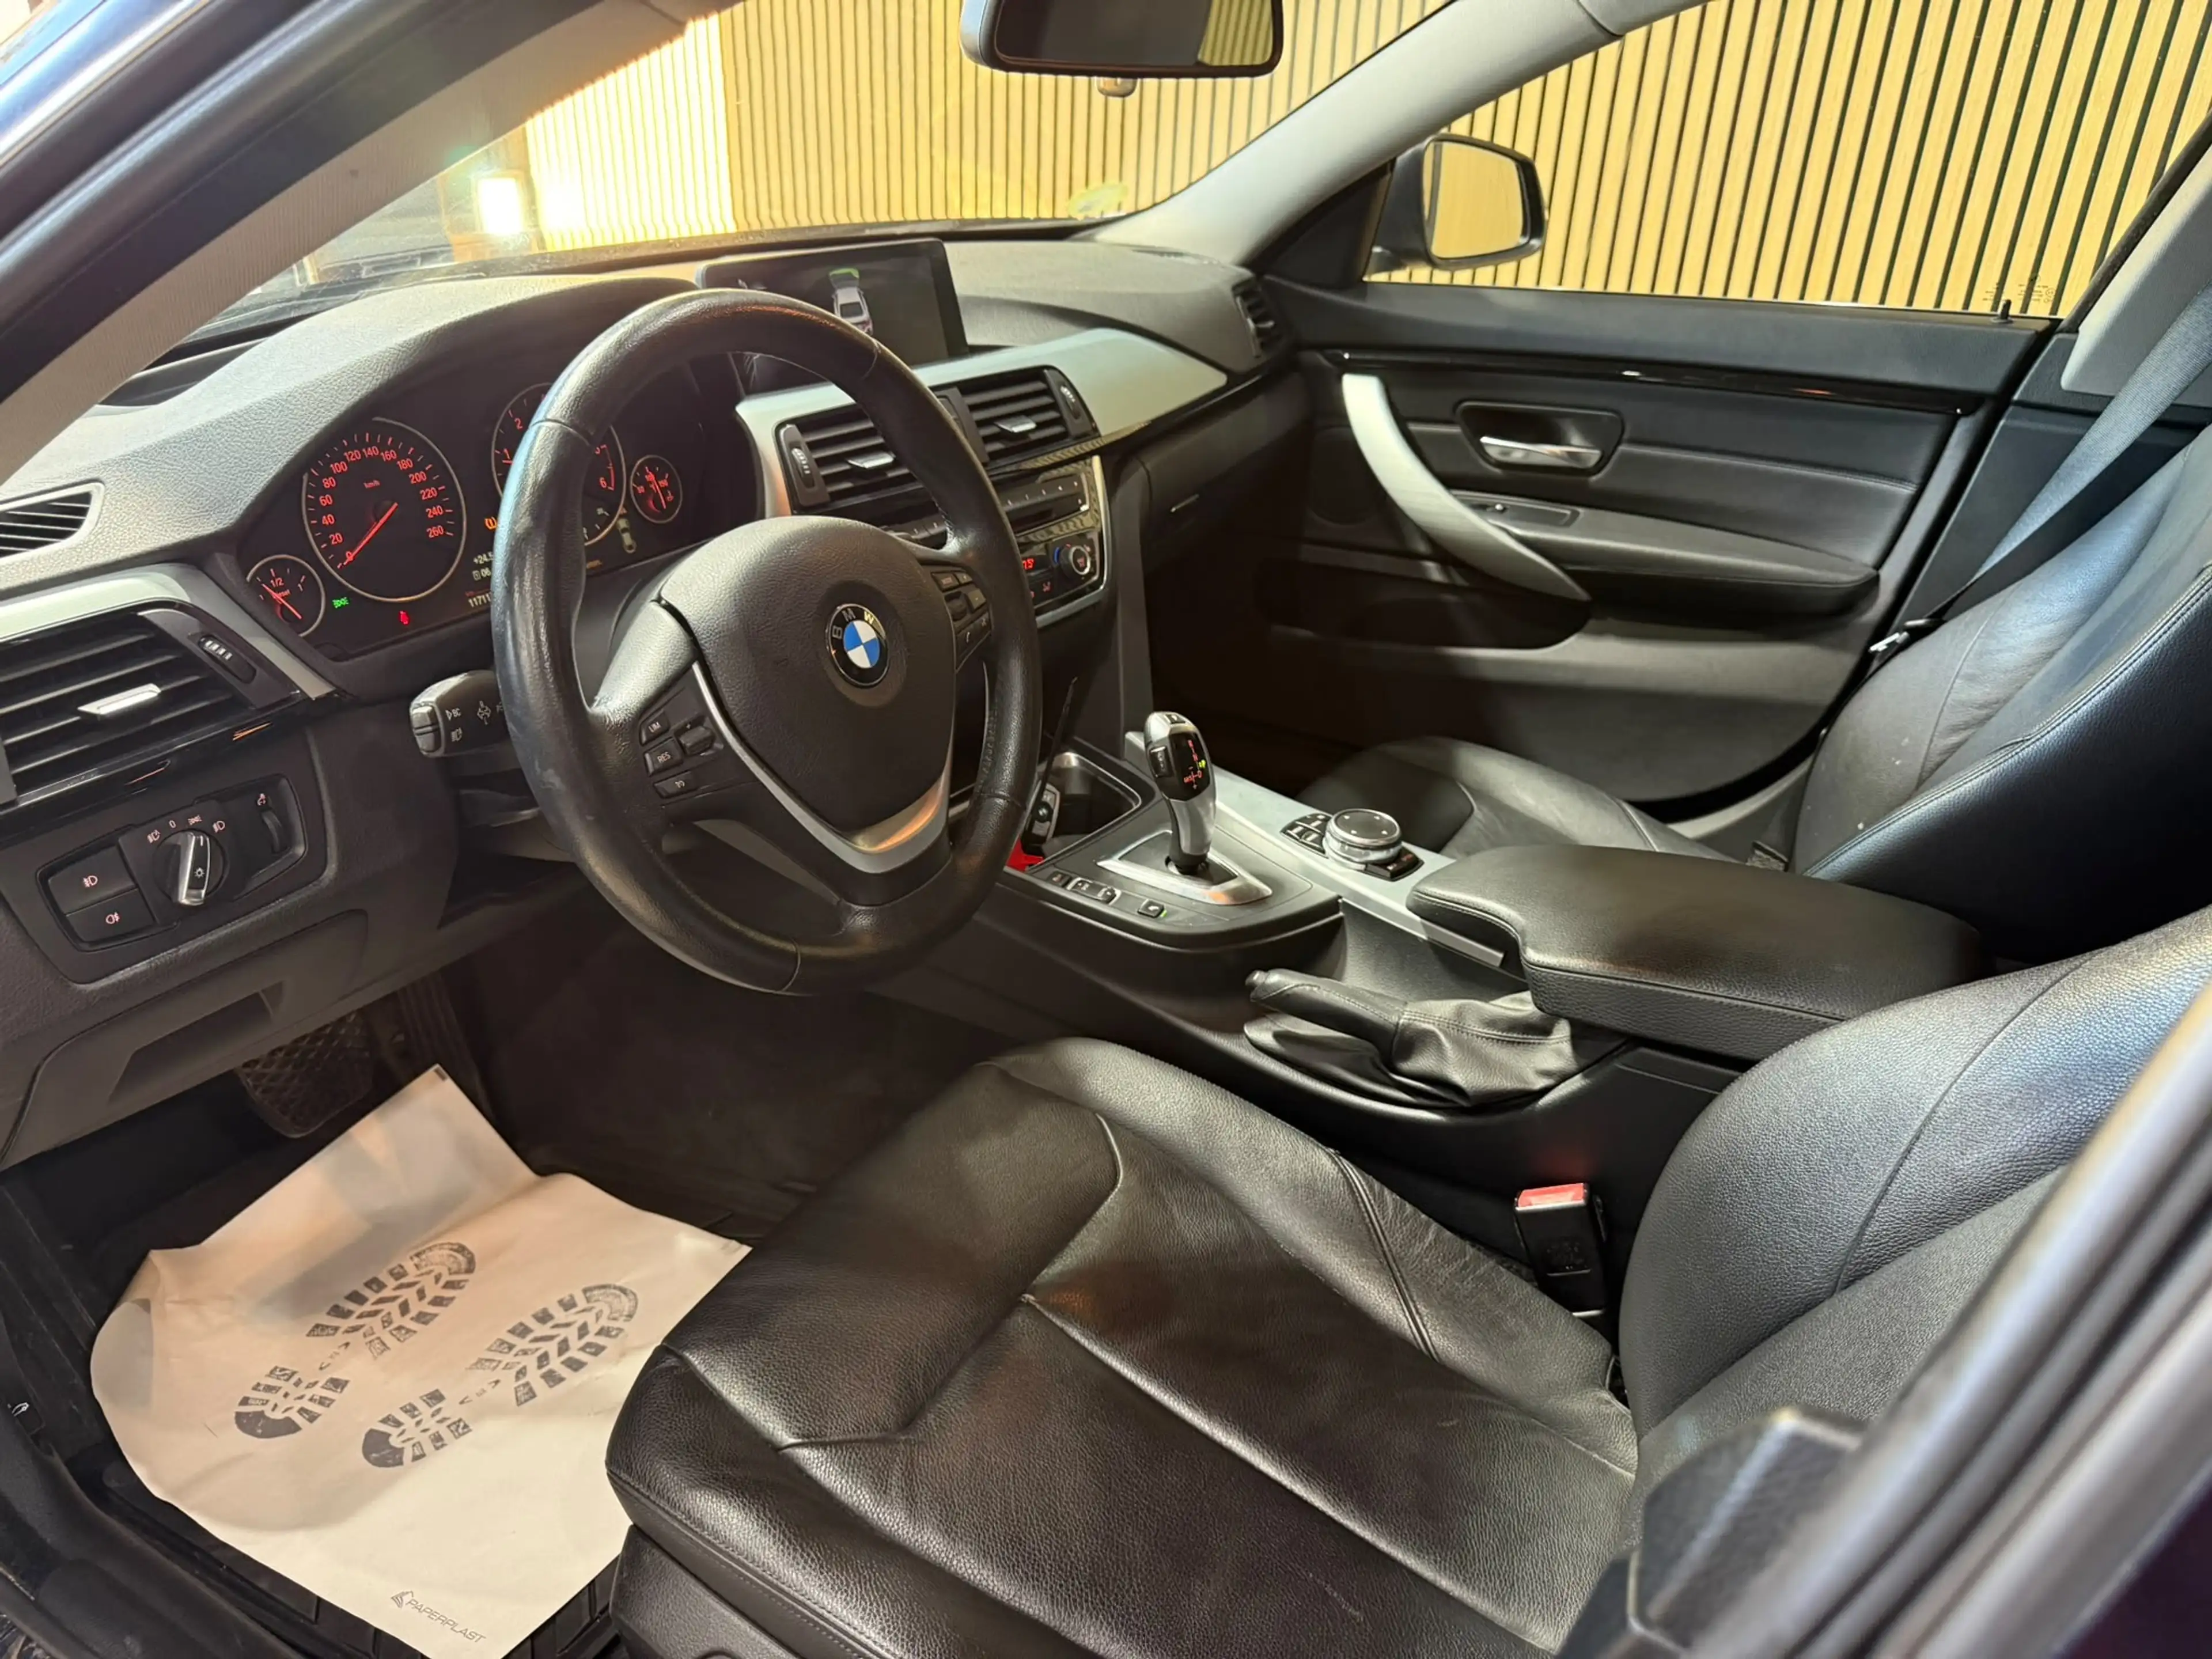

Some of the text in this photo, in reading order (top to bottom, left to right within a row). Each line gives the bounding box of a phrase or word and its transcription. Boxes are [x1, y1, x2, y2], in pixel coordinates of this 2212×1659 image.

[514, 418, 524, 430] 2
[343, 450, 362, 463] 120
[362, 446, 380, 458] 140
[381, 449, 397, 462] 160
[329, 461, 348, 474] 100
[396, 458, 414, 471] 180
[322, 476, 336, 489] 80
[408, 471, 427, 484] 200
[599, 476, 607, 489] 6
[319, 494, 333, 506] 60
[419, 487, 438, 501] 220
[426, 505, 444, 518] 240
[322, 514, 335, 526] 40
[329, 532, 343, 545] 20
[426, 525, 444, 539] 260
[467, 592, 492, 608] 11711
[832, 607, 876, 640] BMW
[657, 751, 672, 763] RES
[405, 1598, 487, 1643] PAPERPLAST
